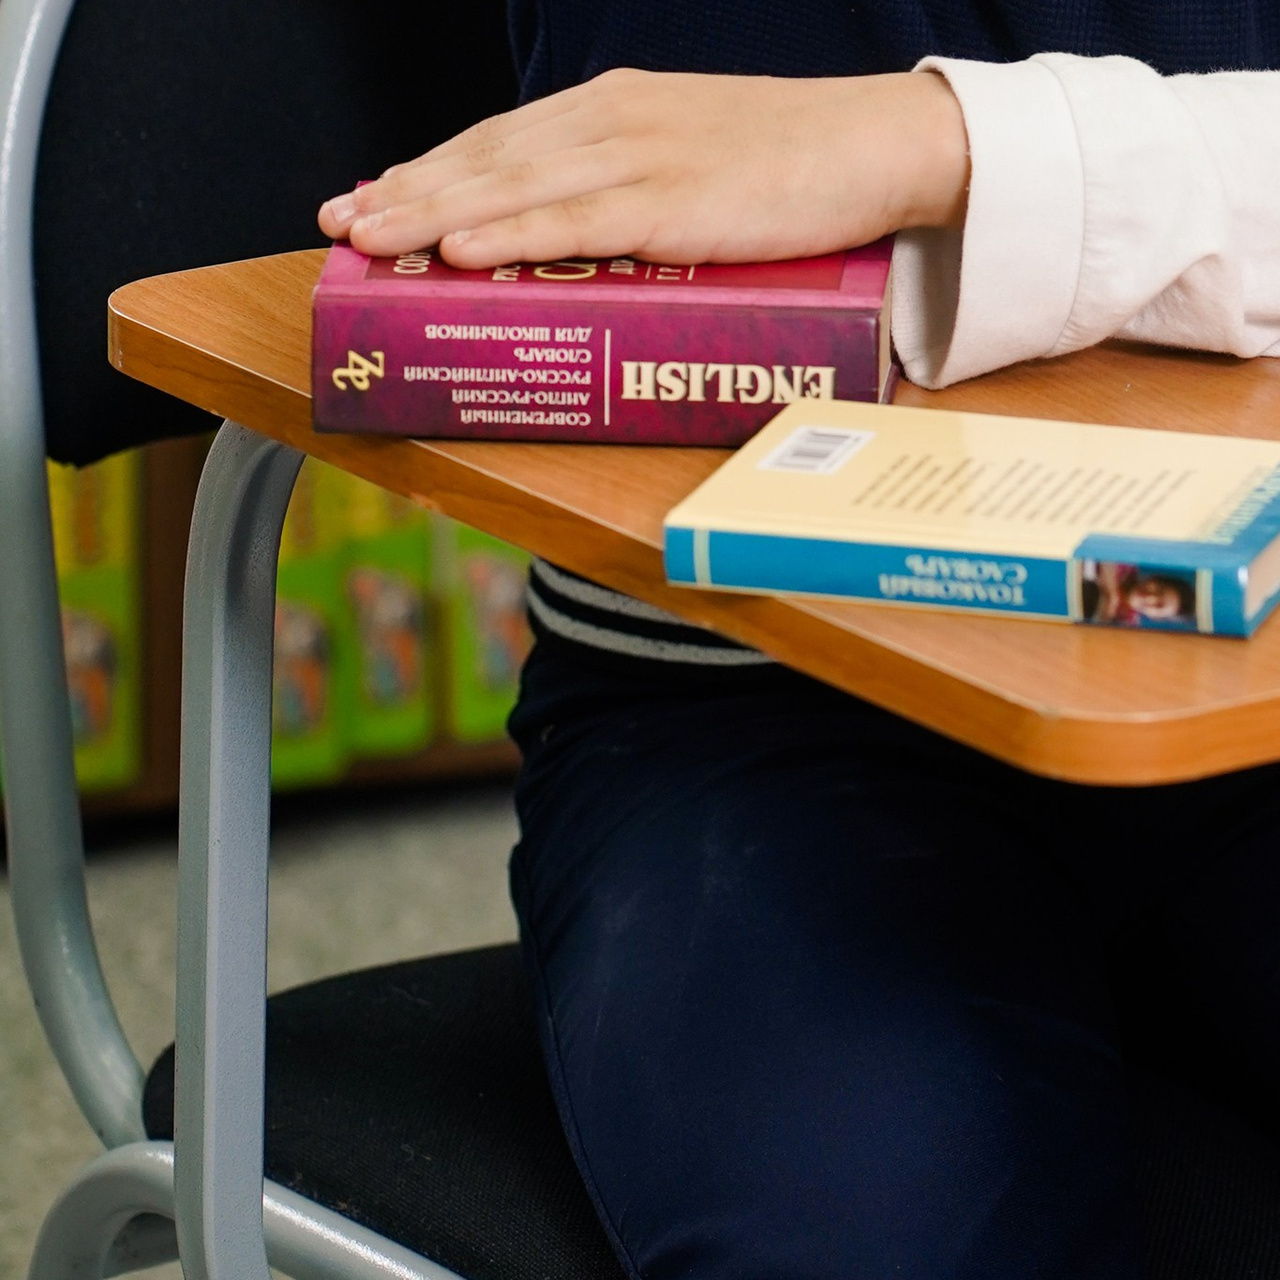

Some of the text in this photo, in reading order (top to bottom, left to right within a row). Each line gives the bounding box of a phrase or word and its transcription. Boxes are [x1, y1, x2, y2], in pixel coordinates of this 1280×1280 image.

[425, 324, 592, 342] ДЛЯ ШКОЛЬНИКОВ
[514, 347, 592, 363] СЛОВАРЬ
[403, 365, 592, 385] РУССКО-АНГЛИЙСКИЙ
[621, 360, 836, 403] ENGLISH
[452, 388, 591, 406] АНГЛО-РУССКИЙ
[460, 408, 592, 426] СОВРЕМЕННЫЙ
[905, 554, 1028, 586] СЛОВАРЬ
